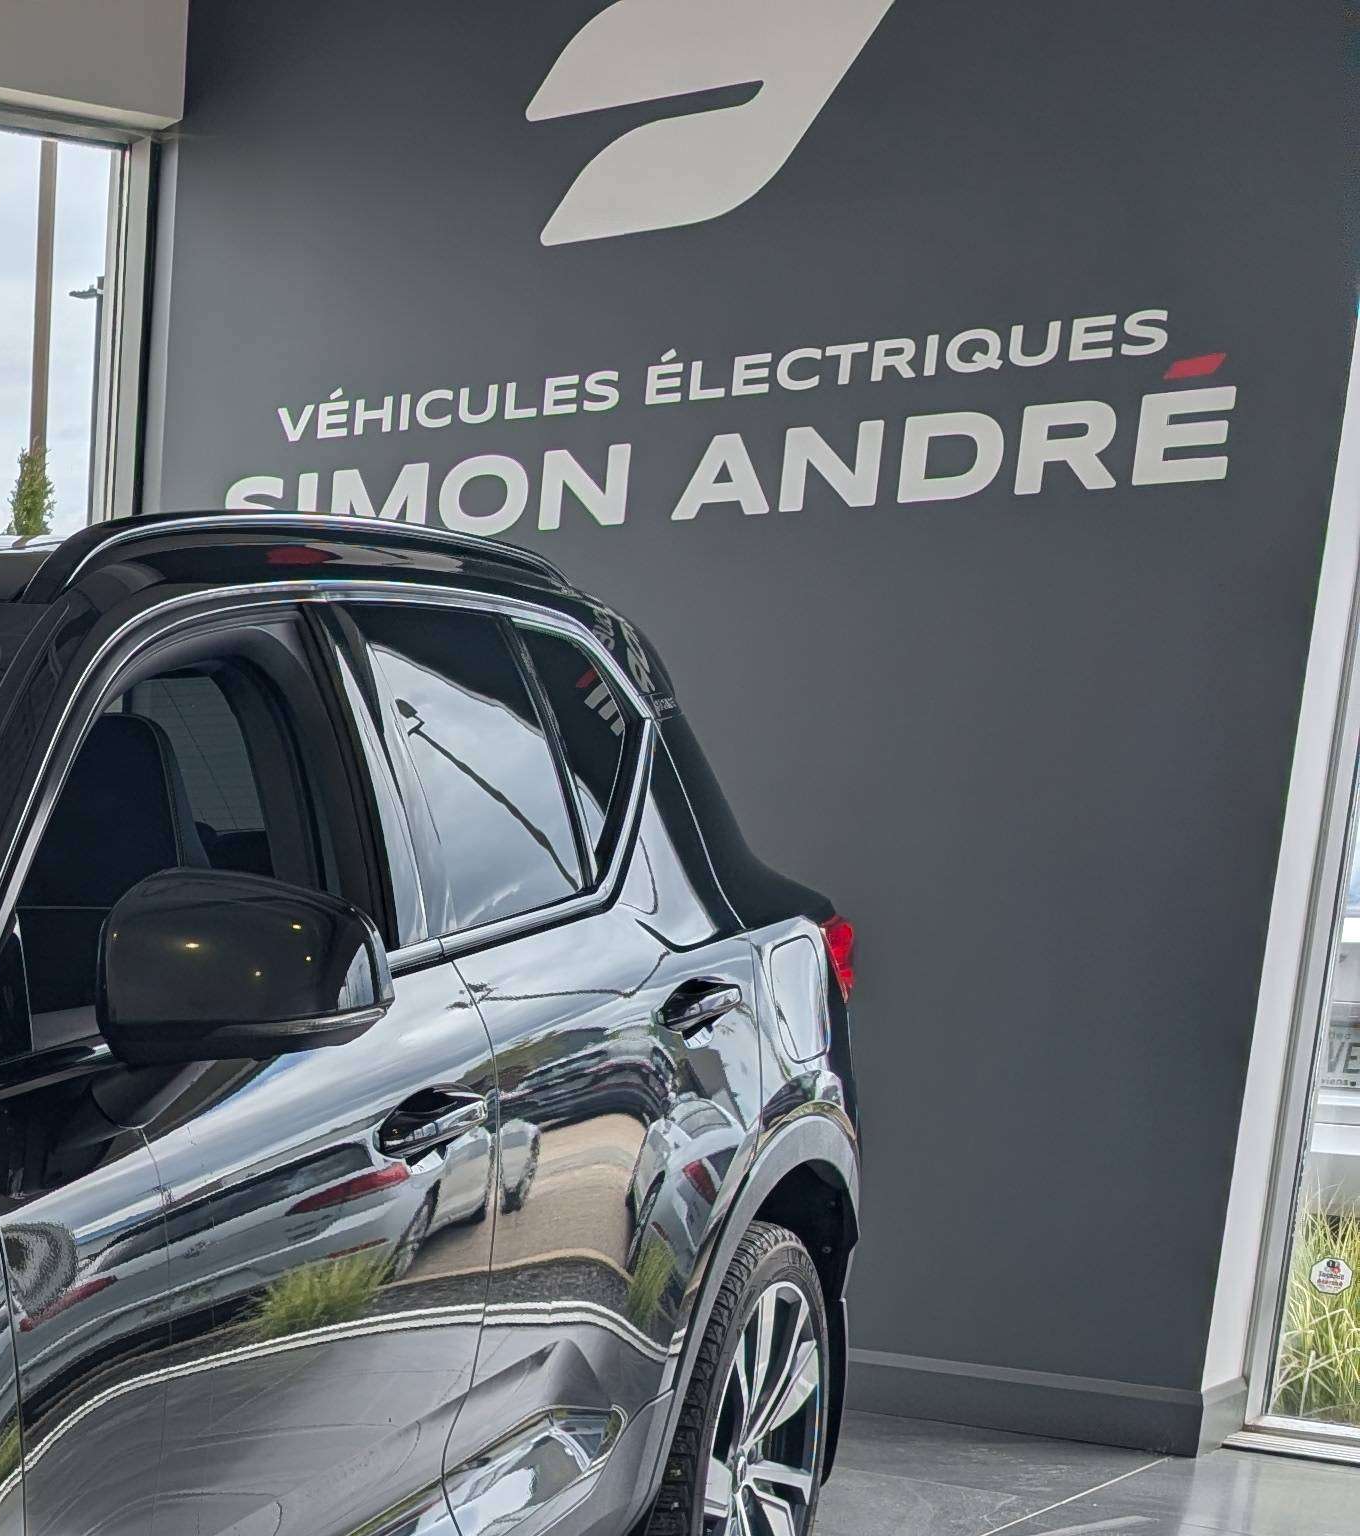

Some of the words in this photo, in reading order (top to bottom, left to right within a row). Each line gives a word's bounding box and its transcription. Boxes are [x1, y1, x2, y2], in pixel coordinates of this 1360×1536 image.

[277, 387, 620, 443] VÉHICULES
[644, 308, 1169, 405] ÉLECTRIQUES
[670, 352, 1237, 521] ANDRÉ
